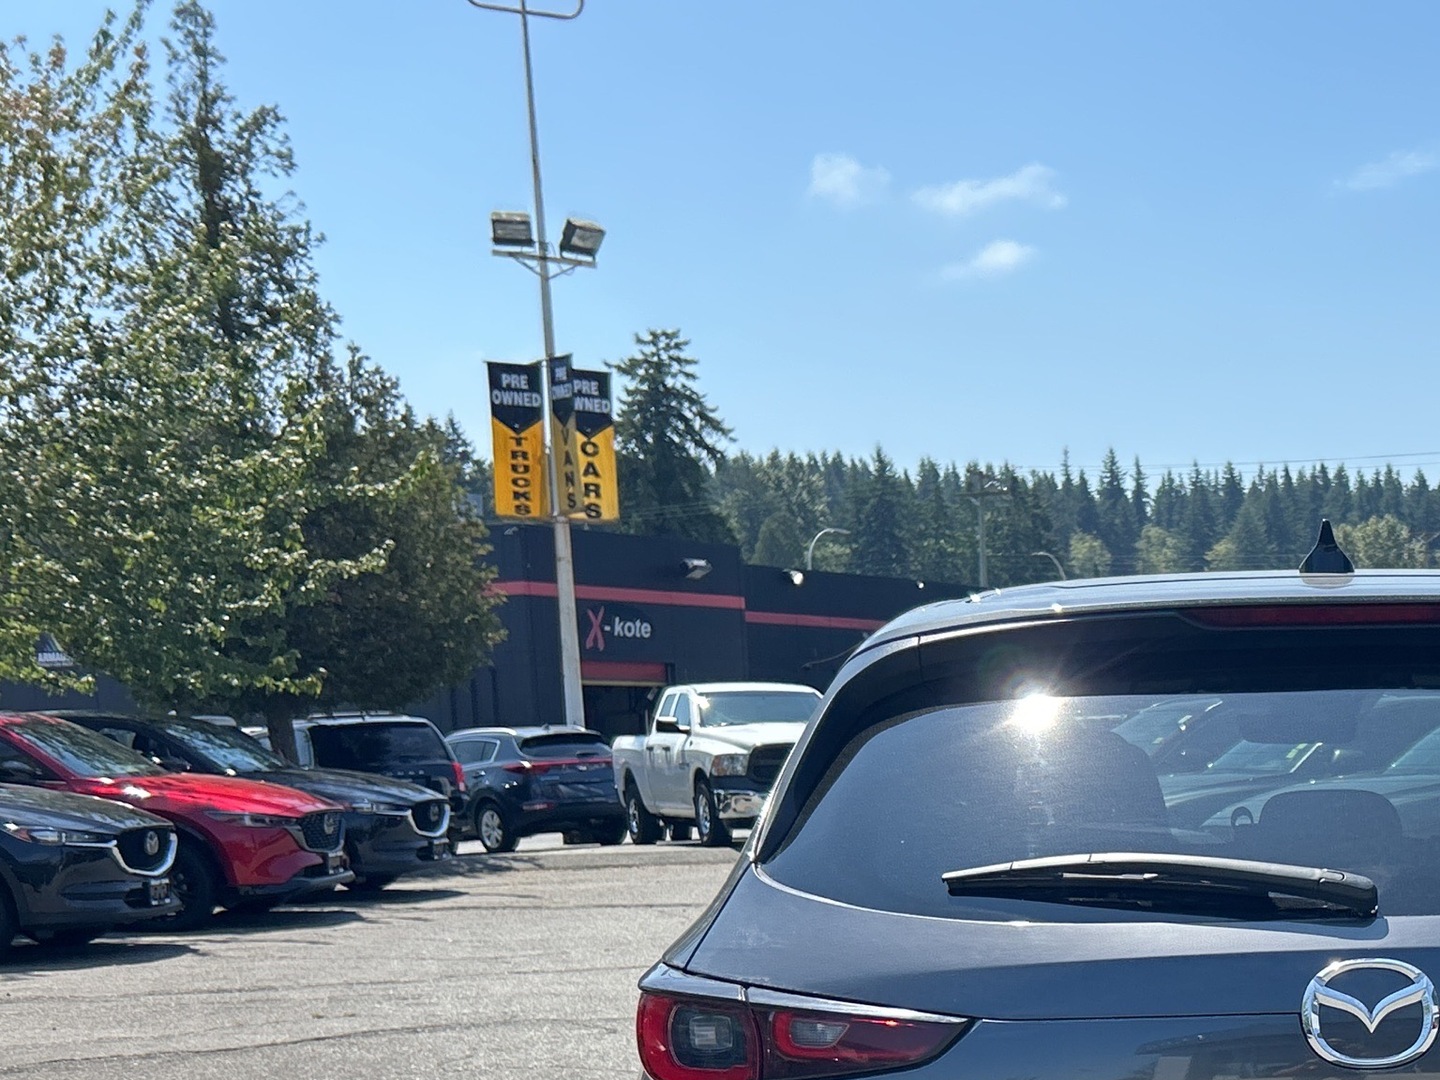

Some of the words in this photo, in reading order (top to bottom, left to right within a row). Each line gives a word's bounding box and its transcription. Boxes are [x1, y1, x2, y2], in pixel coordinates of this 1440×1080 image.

[501, 373, 528, 388] PRE
[573, 380, 599, 395] PRE
[492, 391, 541, 408] OWNED
[574, 398, 611, 414] WNED
[510, 436, 532, 516] TRUCKS
[561, 428, 576, 509] VANS
[580, 441, 602, 519] CARS
